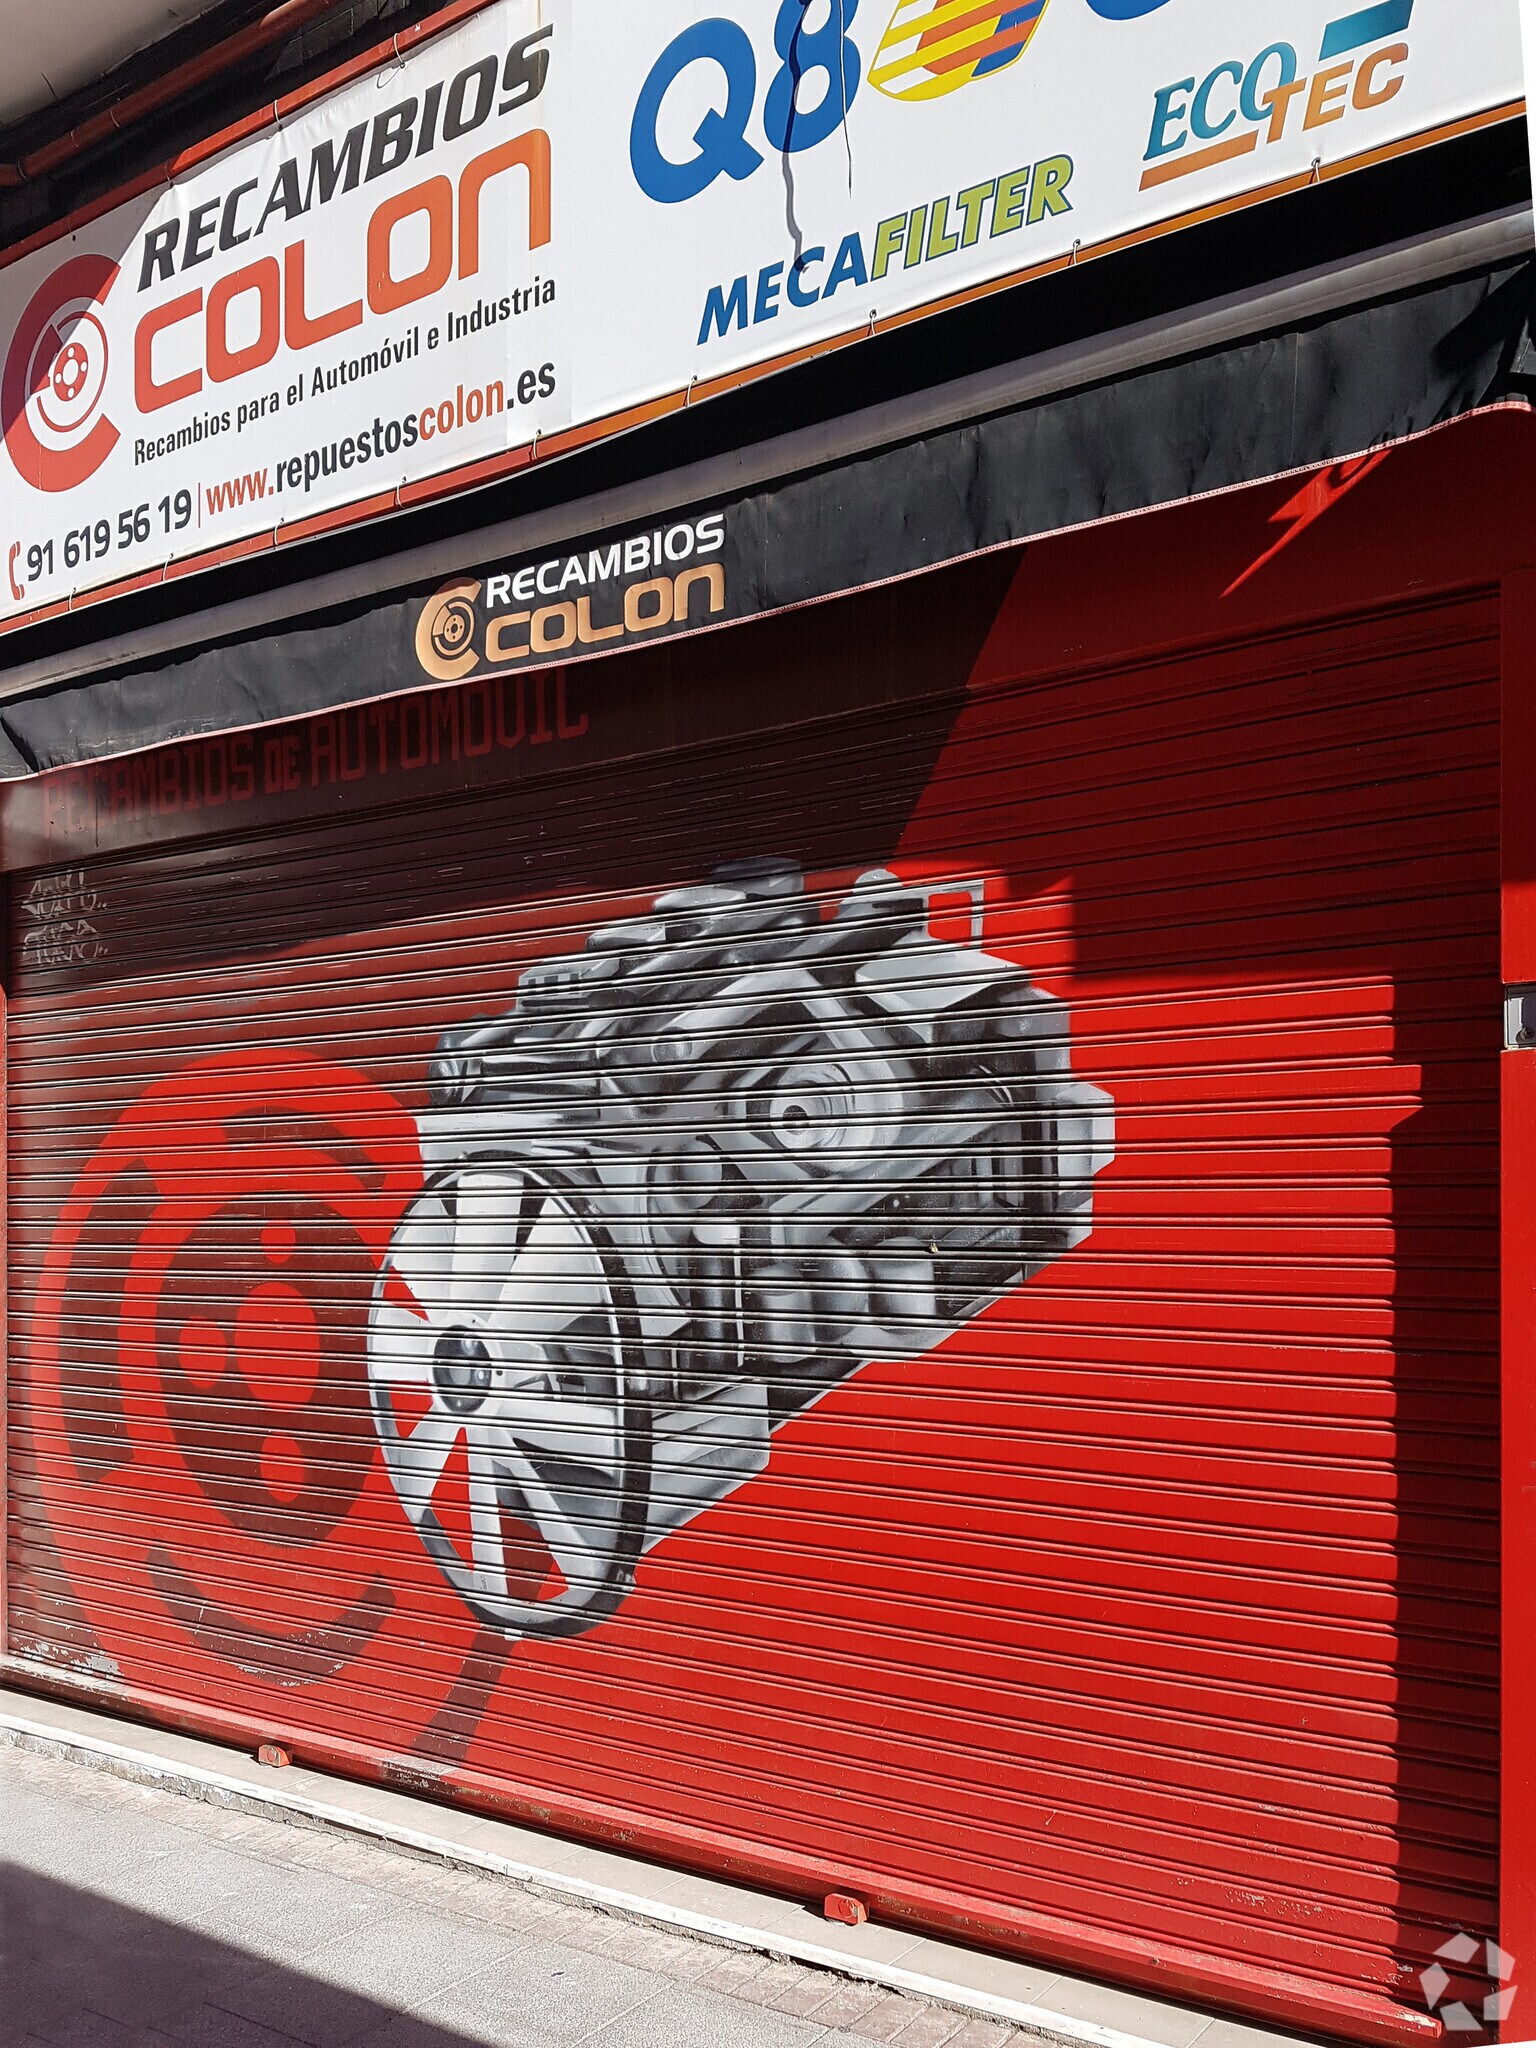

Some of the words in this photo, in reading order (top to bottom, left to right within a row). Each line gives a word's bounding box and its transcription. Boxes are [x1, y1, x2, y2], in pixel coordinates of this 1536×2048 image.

[137, 24, 554, 293] RECAMBIOS
[630, 0, 860, 203] Q8
[134, 128, 551, 414] COLON
[697, 154, 1074, 346] MECAFILTER
[134, 410, 231, 466] Recambios
[237, 392, 280, 433] para
[286, 373, 304, 406] el
[311, 326, 420, 397] Automóvil
[427, 325, 440, 351] e
[447, 275, 556, 341] Industria
[27, 544, 54, 582] 91
[64, 519, 111, 568] 619
[118, 503, 150, 549] 56
[158, 489, 192, 533] 19
[206, 361, 556, 515] www.repuestoscolon.es
[486, 513, 725, 608] RECAMBIOS
[485, 562, 726, 663] COLON
